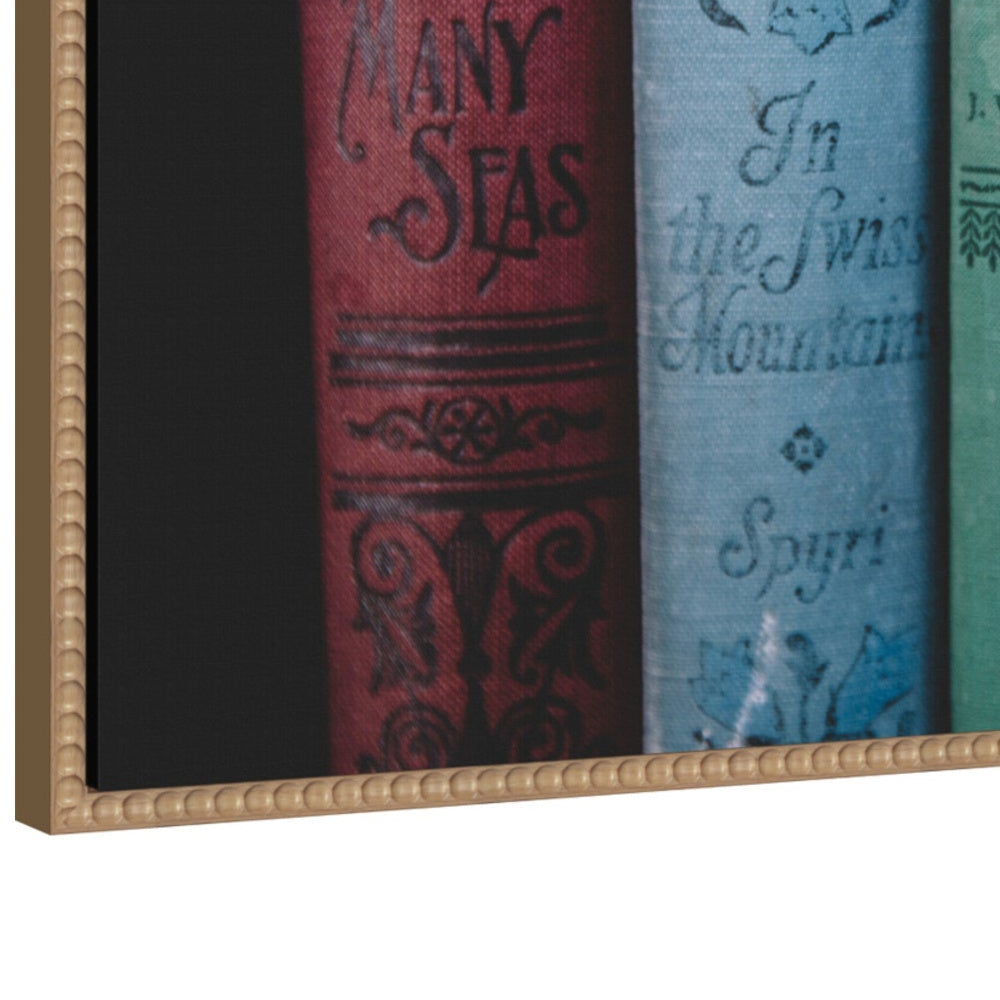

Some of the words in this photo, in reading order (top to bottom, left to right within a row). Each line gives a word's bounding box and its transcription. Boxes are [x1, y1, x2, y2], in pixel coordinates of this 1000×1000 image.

[739, 79, 841, 187] In
[967, 92, 986, 122] J.
[368, 121, 591, 296] SEAS
[667, 193, 762, 276] the
[718, 497, 888, 604] Spyri
